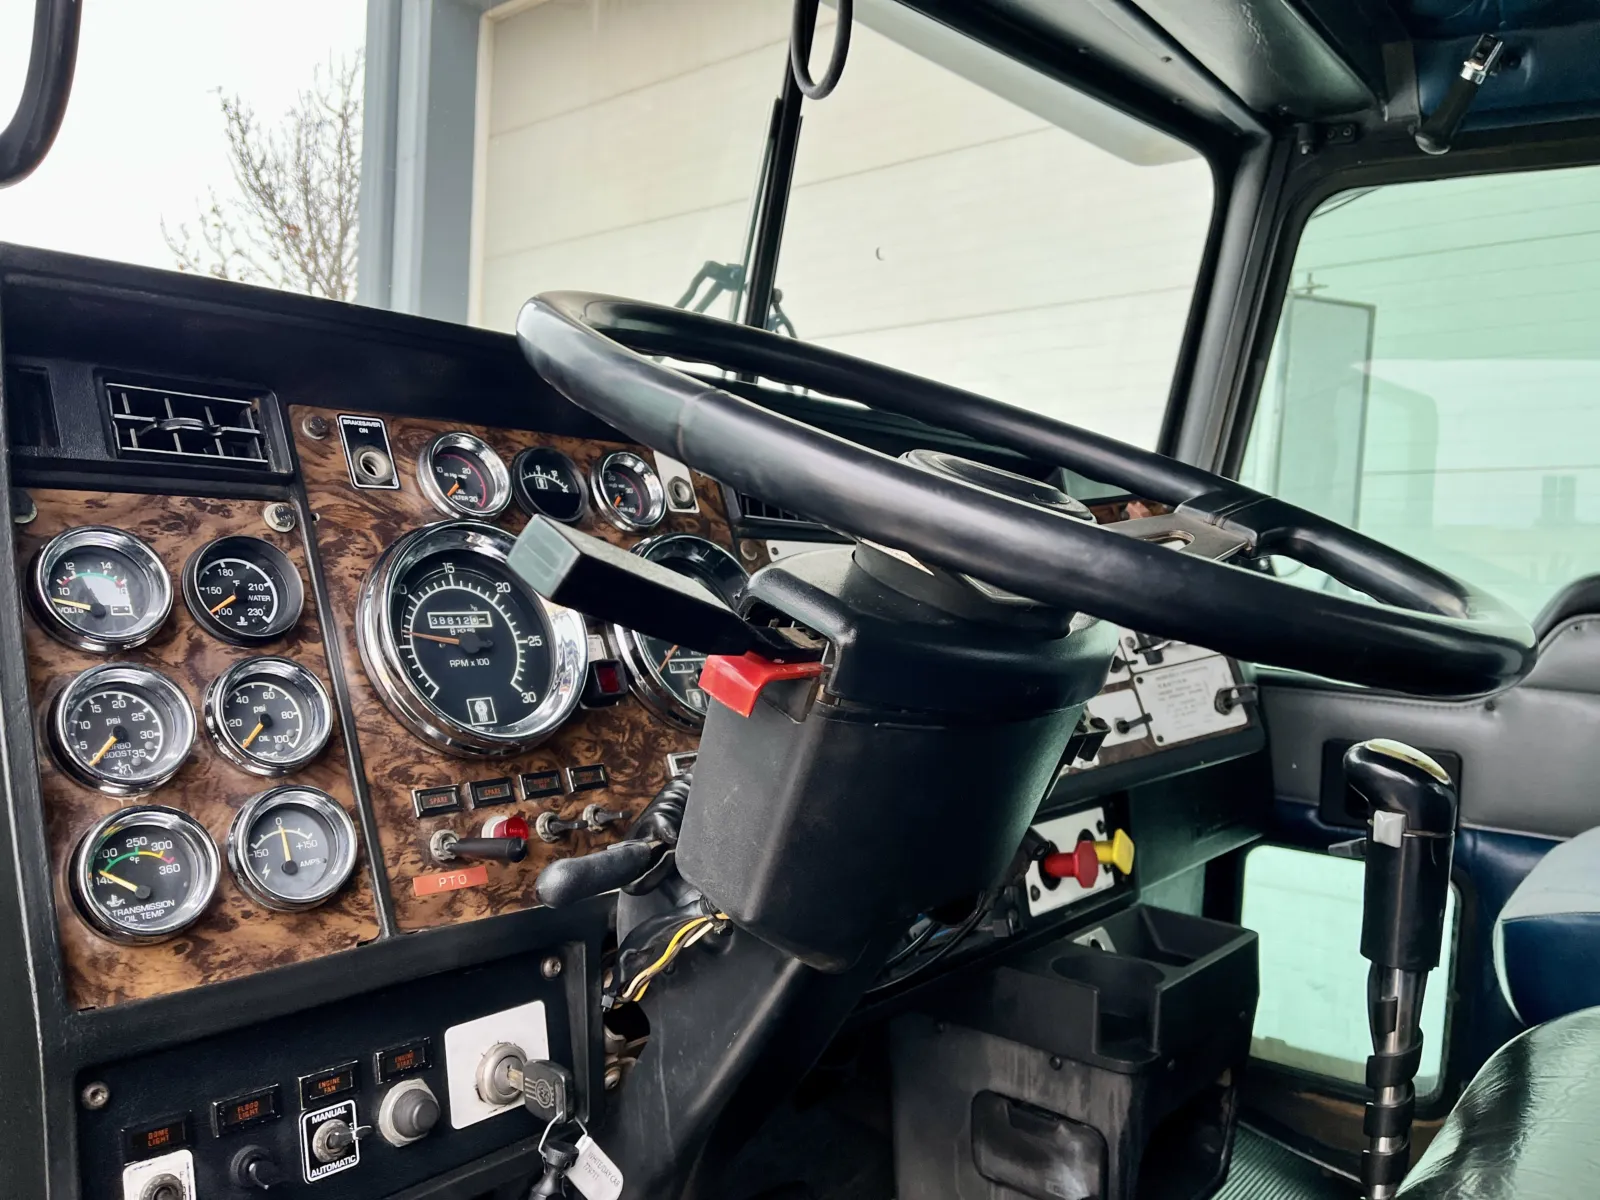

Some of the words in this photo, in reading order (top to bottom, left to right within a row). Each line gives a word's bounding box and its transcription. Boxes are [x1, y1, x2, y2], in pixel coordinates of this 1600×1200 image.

[64, 562, 75, 570] 12
[101, 562, 112, 570] 14
[442, 563, 455, 573] 15
[218, 569, 234, 577] 180
[58, 587, 70, 596] 10
[206, 586, 222, 595] 150
[248, 583, 265, 592] 210
[495, 582, 511, 593] 20
[218, 608, 233, 616] 100
[247, 608, 264, 616] 230
[528, 635, 542, 647] 25
[449, 660, 469, 668] RPM
[476, 658, 490, 666] 100
[236, 696, 249, 704] 40
[262, 692, 275, 700] 60
[521, 692, 536, 704] 30
[90, 704, 102, 713] 15
[111, 700, 127, 709] 20
[253, 704, 267, 713] psi
[131, 713, 146, 721] 25
[281, 711, 294, 719] 80
[79, 721, 91, 730] 10
[106, 716, 121, 726] psi
[229, 719, 243, 727] 20
[140, 730, 154, 739] 30
[273, 735, 290, 743] 100
[80, 741, 88, 750] 5
[108, 742, 132, 750] URBO
[103, 750, 132, 759] BOOST
[131, 749, 147, 758] 35
[275, 817, 282, 825] 0
[126, 836, 147, 848] 250
[151, 840, 173, 851] 300
[296, 839, 318, 850] +150
[101, 848, 118, 858] 00
[249, 848, 269, 858] -150
[158, 863, 180, 875] 360
[438, 874, 467, 888] PTO
[112, 899, 175, 917] TRANSMISSION
[141, 909, 165, 920] TEMP
[318, 1076, 341, 1089] ENGINE
[324, 1085, 336, 1094] FAN
[238, 1107, 259, 1120] LIGHT
[311, 1106, 347, 1124] MANUAL
[148, 1128, 169, 1139] DOME
[148, 1135, 169, 1147] LIGHT
[311, 1155, 357, 1178] AUTOMATIC
